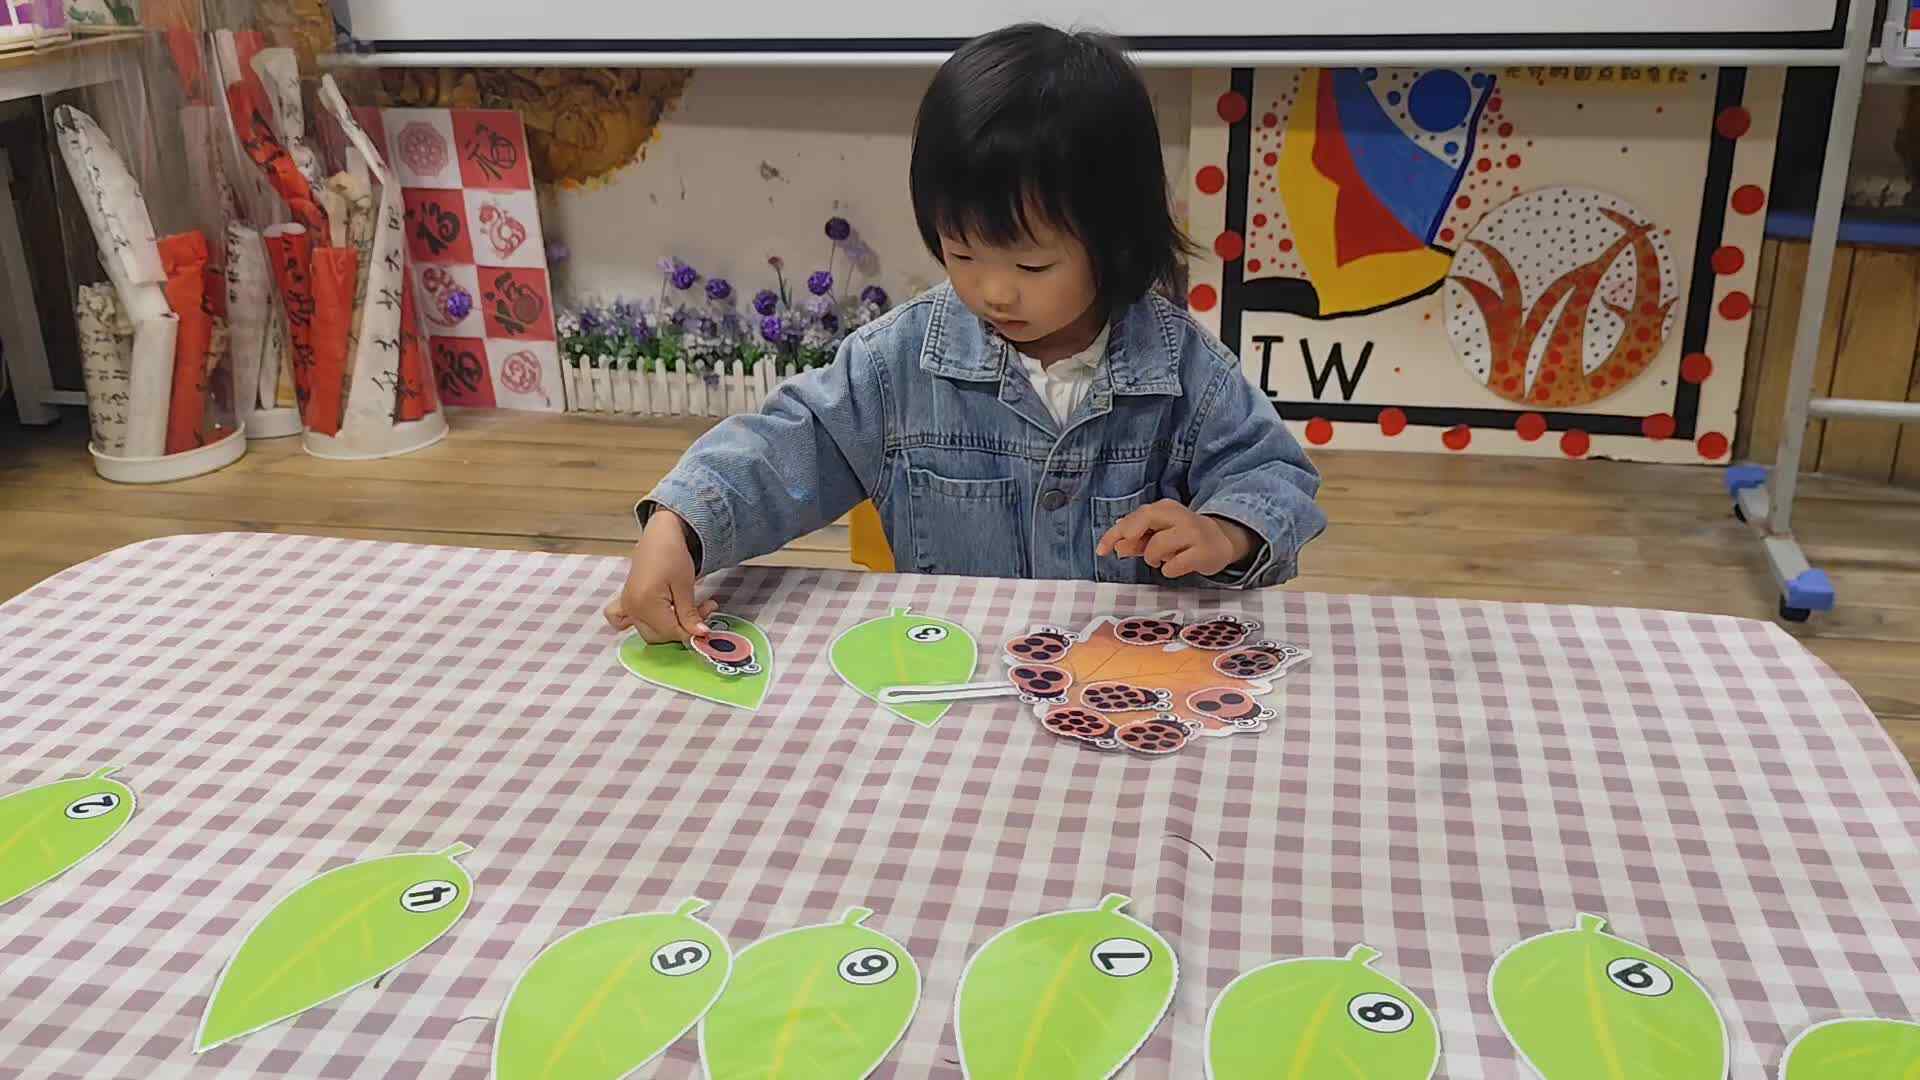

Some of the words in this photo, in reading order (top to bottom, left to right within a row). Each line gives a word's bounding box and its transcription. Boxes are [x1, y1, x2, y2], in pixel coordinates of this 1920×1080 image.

[914, 627, 941, 640] 3
[72, 795, 114, 813] 2
[408, 886, 451, 907] 4
[657, 947, 702, 970] 5
[846, 954, 889, 977] 6
[1097, 952, 1145, 971] 7
[1357, 1001, 1404, 1023] 8
